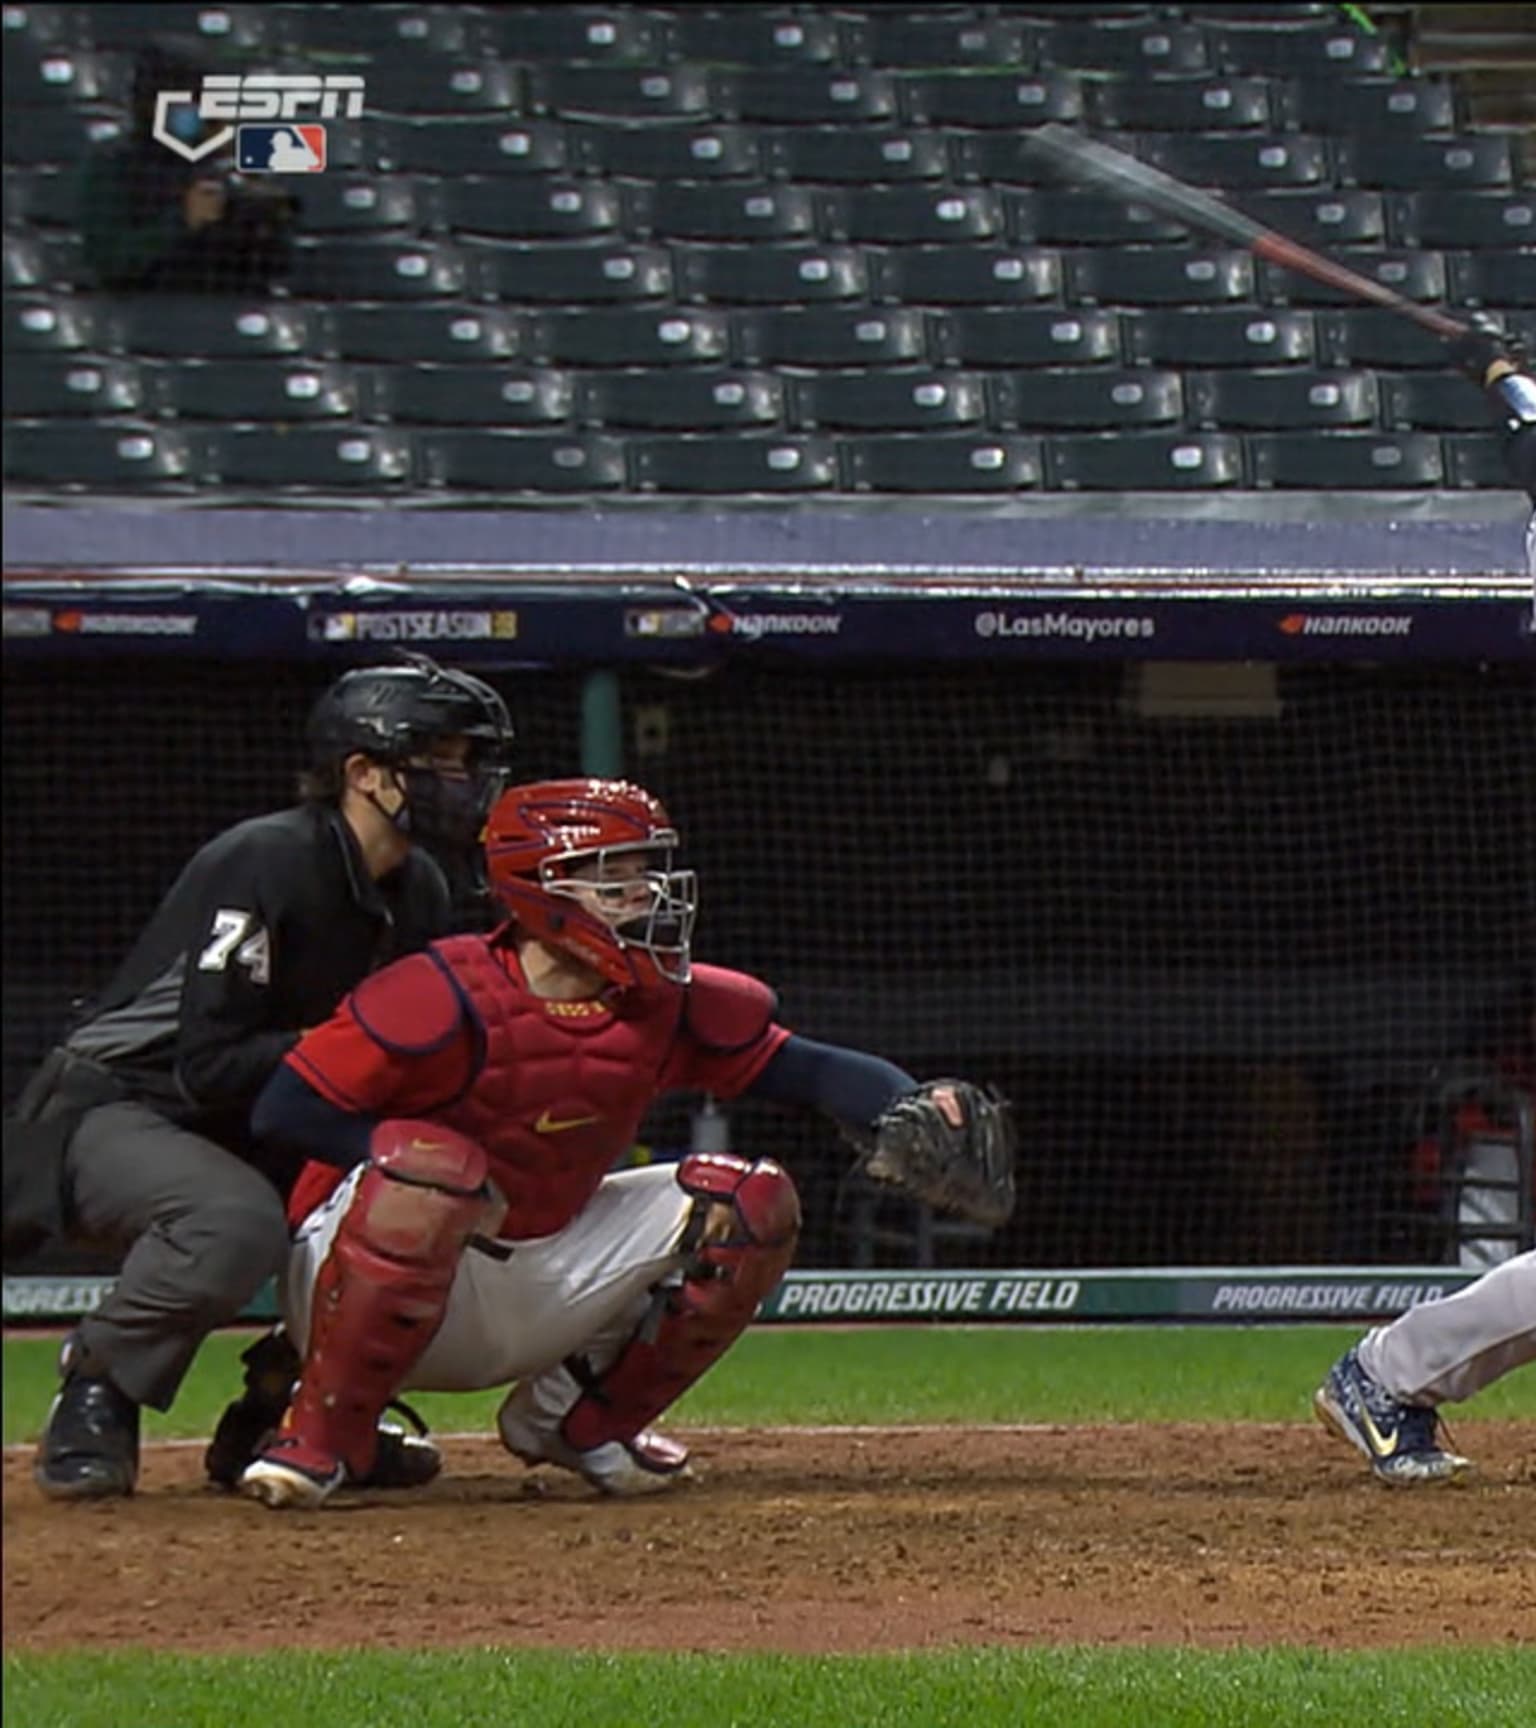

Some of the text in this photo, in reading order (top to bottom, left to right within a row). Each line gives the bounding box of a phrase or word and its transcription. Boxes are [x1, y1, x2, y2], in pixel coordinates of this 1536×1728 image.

[356, 612, 491, 639] POSTSEASON
[975, 613, 1155, 641] @LasMayores
[198, 908, 270, 985] 74
[777, 1281, 1080, 1313] PROGRESSIVE FIELD
[1212, 1286, 1443, 1310] PROGRESSIVE FIELD
